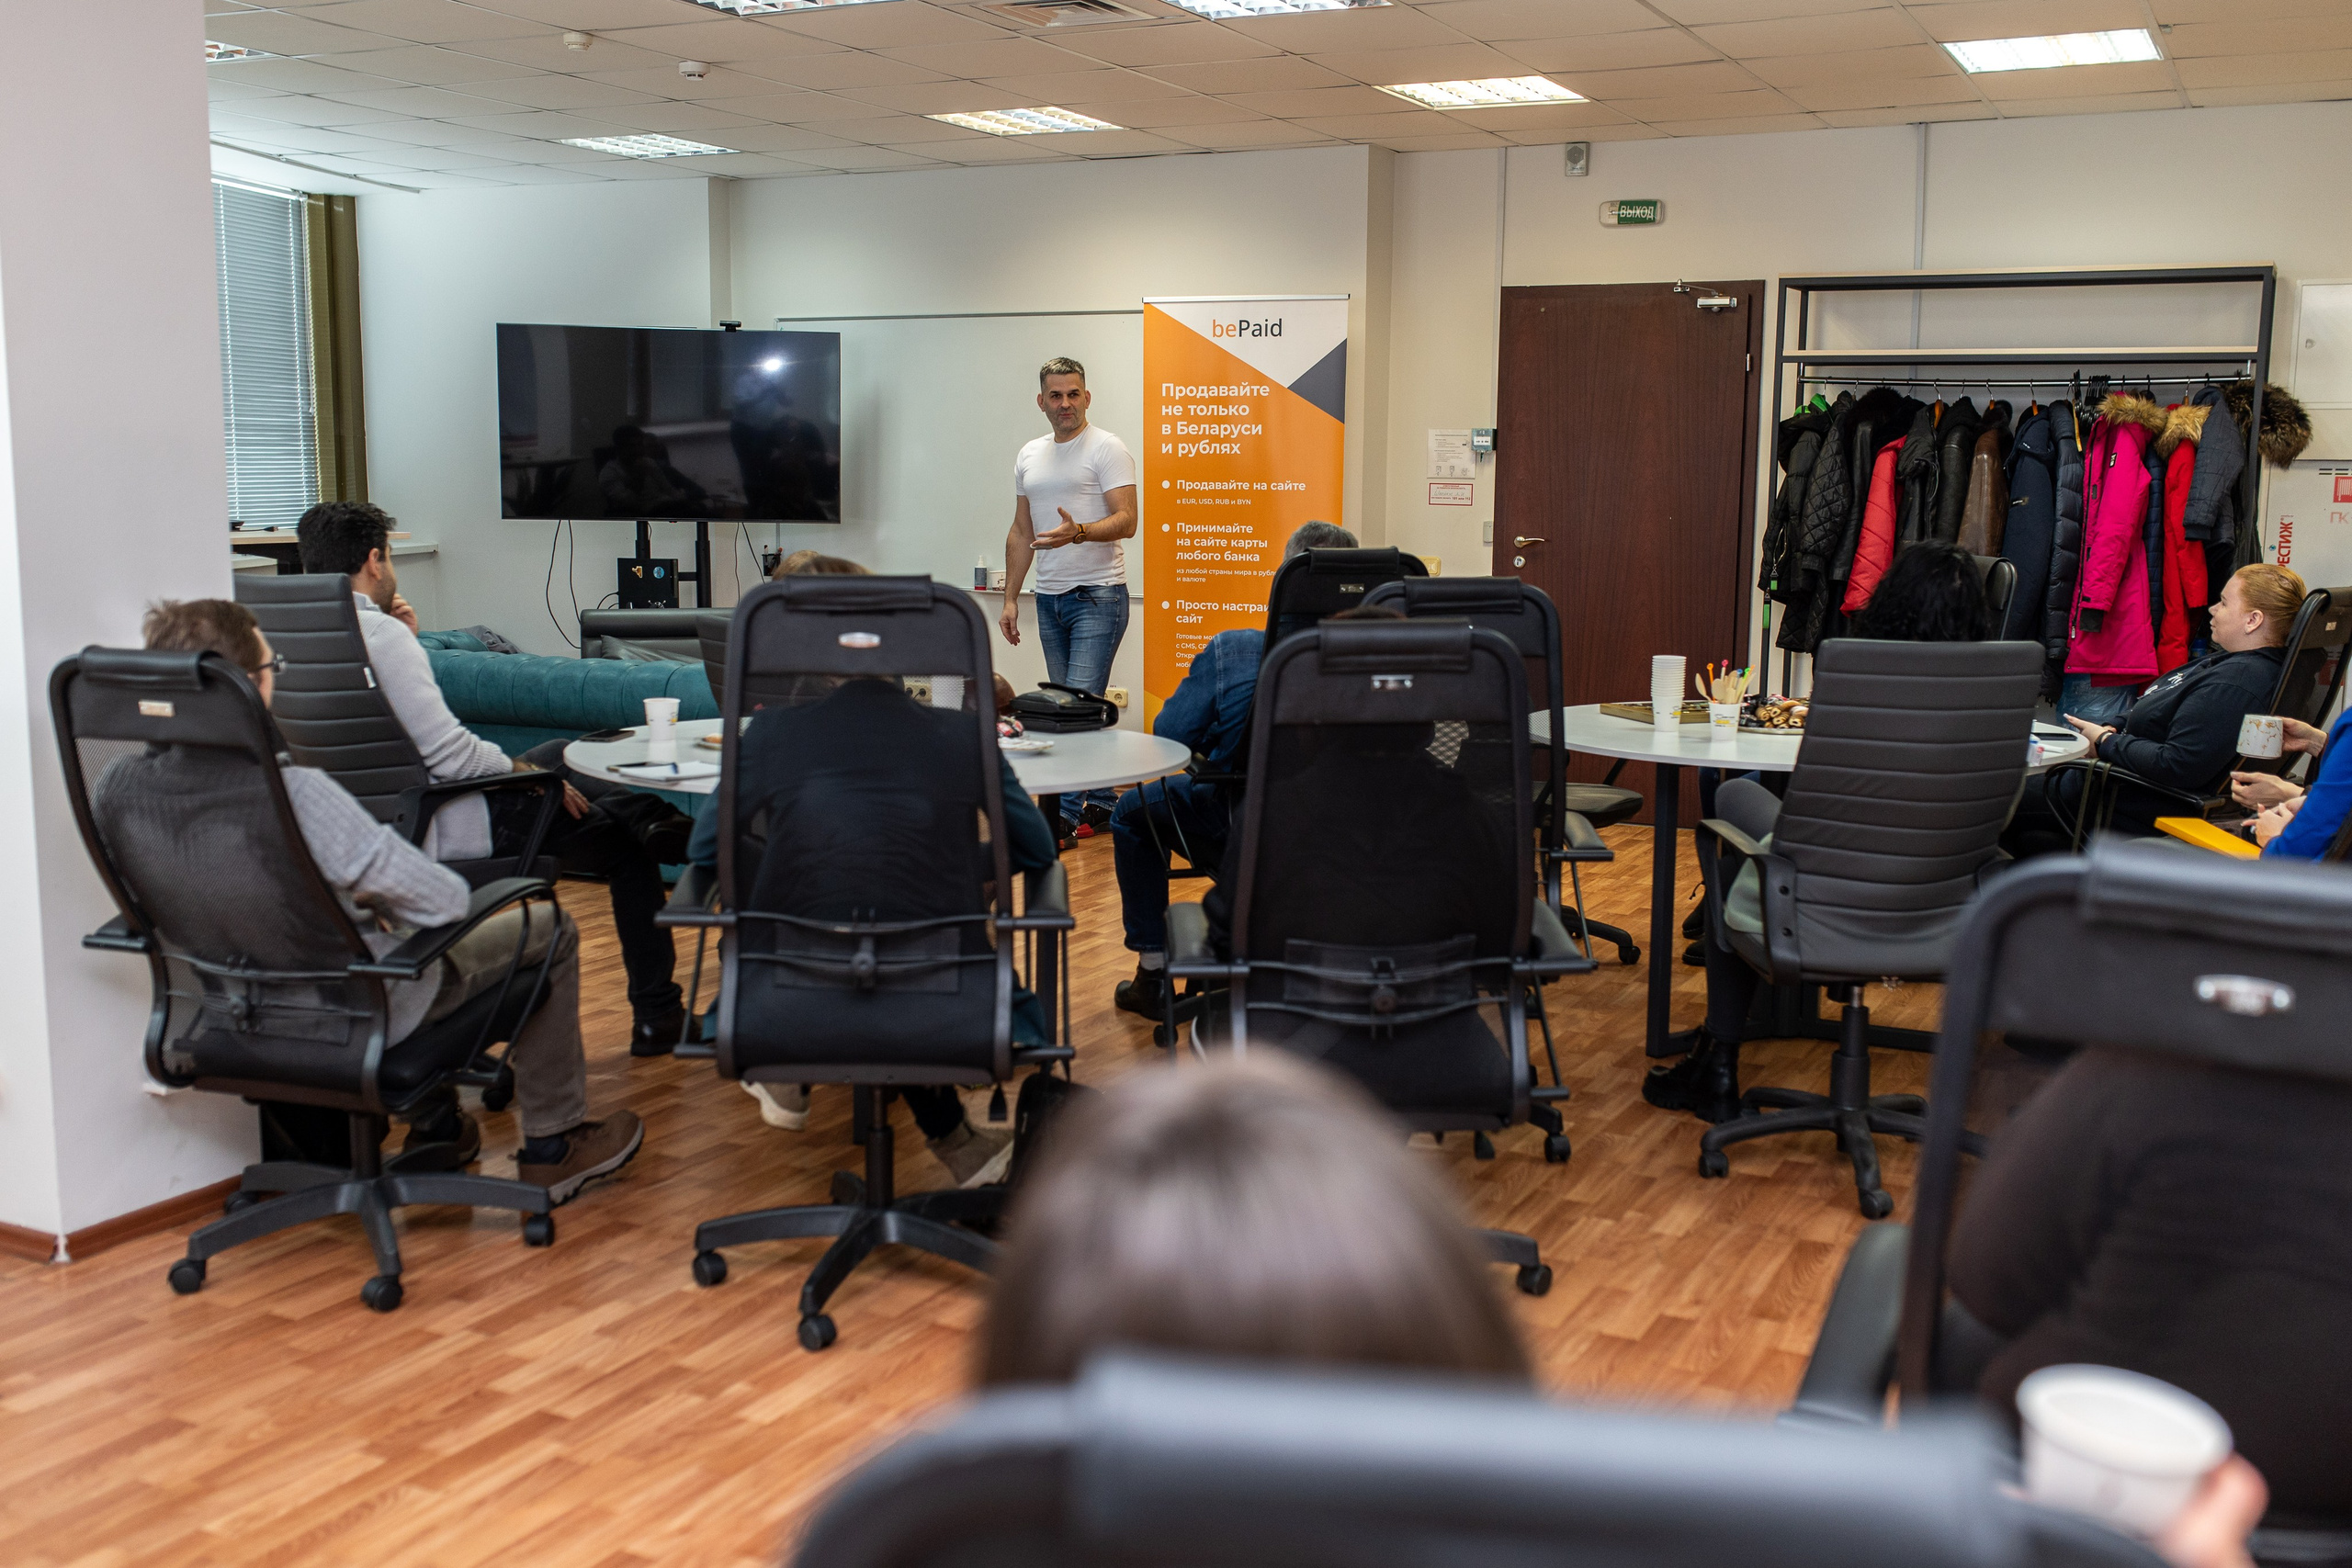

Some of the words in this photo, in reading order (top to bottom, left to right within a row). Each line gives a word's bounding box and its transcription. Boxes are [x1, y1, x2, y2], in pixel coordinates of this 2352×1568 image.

[1620, 205, 1654, 220] ВЫХОД
[1212, 318, 1283, 338] bePaid
[1162, 382, 1270, 400] Продавайте
[1162, 405, 1183, 416] не
[1187, 405, 1250, 416] только
[1162, 424, 1171, 435] в
[1176, 421, 1262, 438] Беларуси
[1162, 443, 1173, 454] и
[1178, 440, 1241, 457] рублях
[1176, 480, 1250, 492] Продавайте
[1253, 482, 1267, 490] на
[1270, 480, 1306, 491] сайте
[2330, 512, 2348, 524] ПК
[1176, 522, 1254, 534] Принимайте
[1176, 538, 1190, 546] на
[1194, 536, 1228, 547] сайте
[1231, 539, 1267, 550] карты
[1176, 550, 1221, 561] любого
[1223, 551, 1260, 562] банка
[1176, 599, 1220, 611] Просто
[1176, 613, 1203, 623] сайт
